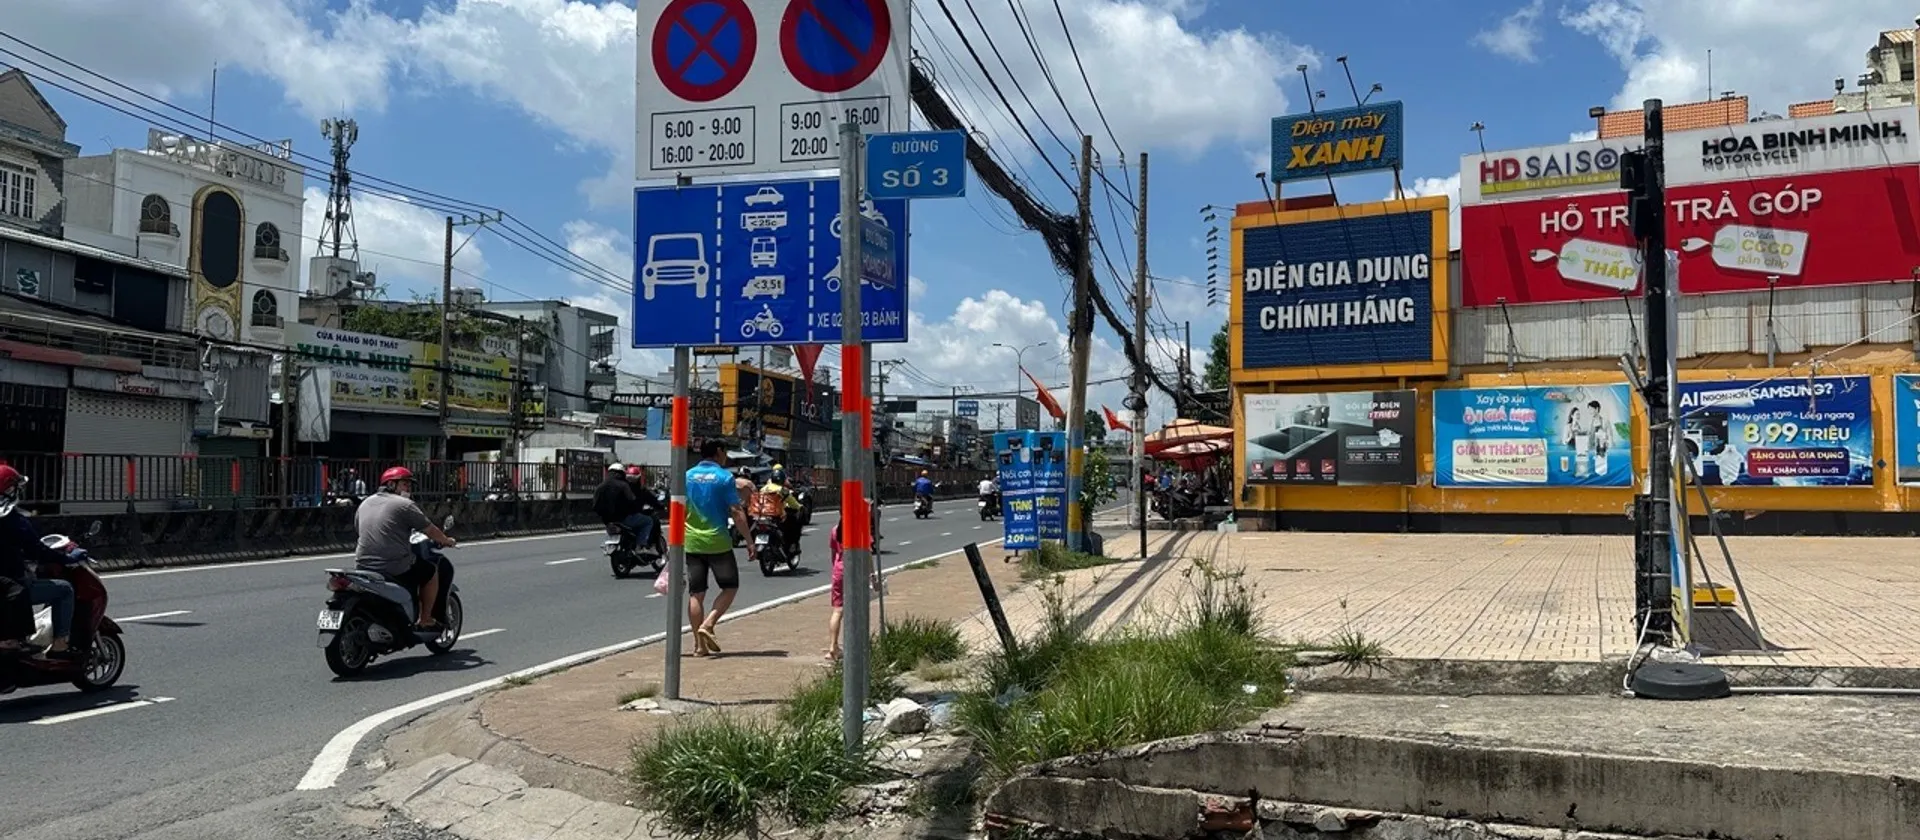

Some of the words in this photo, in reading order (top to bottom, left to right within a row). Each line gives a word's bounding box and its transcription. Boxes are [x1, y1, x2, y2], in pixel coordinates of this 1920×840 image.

[665, 121, 693, 139] 6:00
[712, 117, 741, 135] 9:00
[791, 111, 821, 130] 9:00
[845, 107, 879, 125] 16:00
[1291, 118, 1335, 137] Điện
[1340, 112, 1386, 131] máy
[661, 146, 693, 164] 16:00
[709, 143, 744, 160] 20:00
[791, 137, 827, 156] 20:00
[891, 138, 939, 154] ĐƯỜNG
[1286, 134, 1386, 170] XANH
[1480, 158, 1521, 184] HD
[1525, 147, 1640, 179] SAISO
[1702, 149, 1798, 167] MOTORCYCLE
[882, 161, 923, 188] SỐ
[933, 168, 948, 186] 3
[1540, 202, 1584, 234] HỖ
[1671, 190, 1739, 222] TRẢ
[1749, 183, 1823, 216] GÓP
[1741, 238, 1794, 257] CCCD
[1245, 260, 1304, 296] ĐIỆN
[1309, 260, 1351, 287] GIA
[1357, 253, 1429, 288] DỤNG
[1584, 256, 1636, 280] THẤP
[817, 312, 830, 328] XE
[872, 306, 900, 327] BÁNH
[1260, 296, 1338, 331] CHÍNH
[1344, 294, 1415, 326] HÃNG
[1476, 394, 1496, 406] Xay
[1680, 391, 1698, 408] AI
[1732, 411, 1752, 423] Máy
[1753, 410, 1771, 422] giặt
[1824, 411, 1855, 421] ngang
[1743, 422, 1799, 446] 8,99
[1802, 421, 1850, 445] TRIỆU
[1488, 440, 1519, 456] THÊM
[1751, 451, 1776, 461] TẶNG
[1800, 450, 1816, 459] GIA
[1818, 450, 1845, 460] DỤNG
[1757, 465, 1773, 474] TRẢ
[1774, 465, 1797, 475] CHẬM
